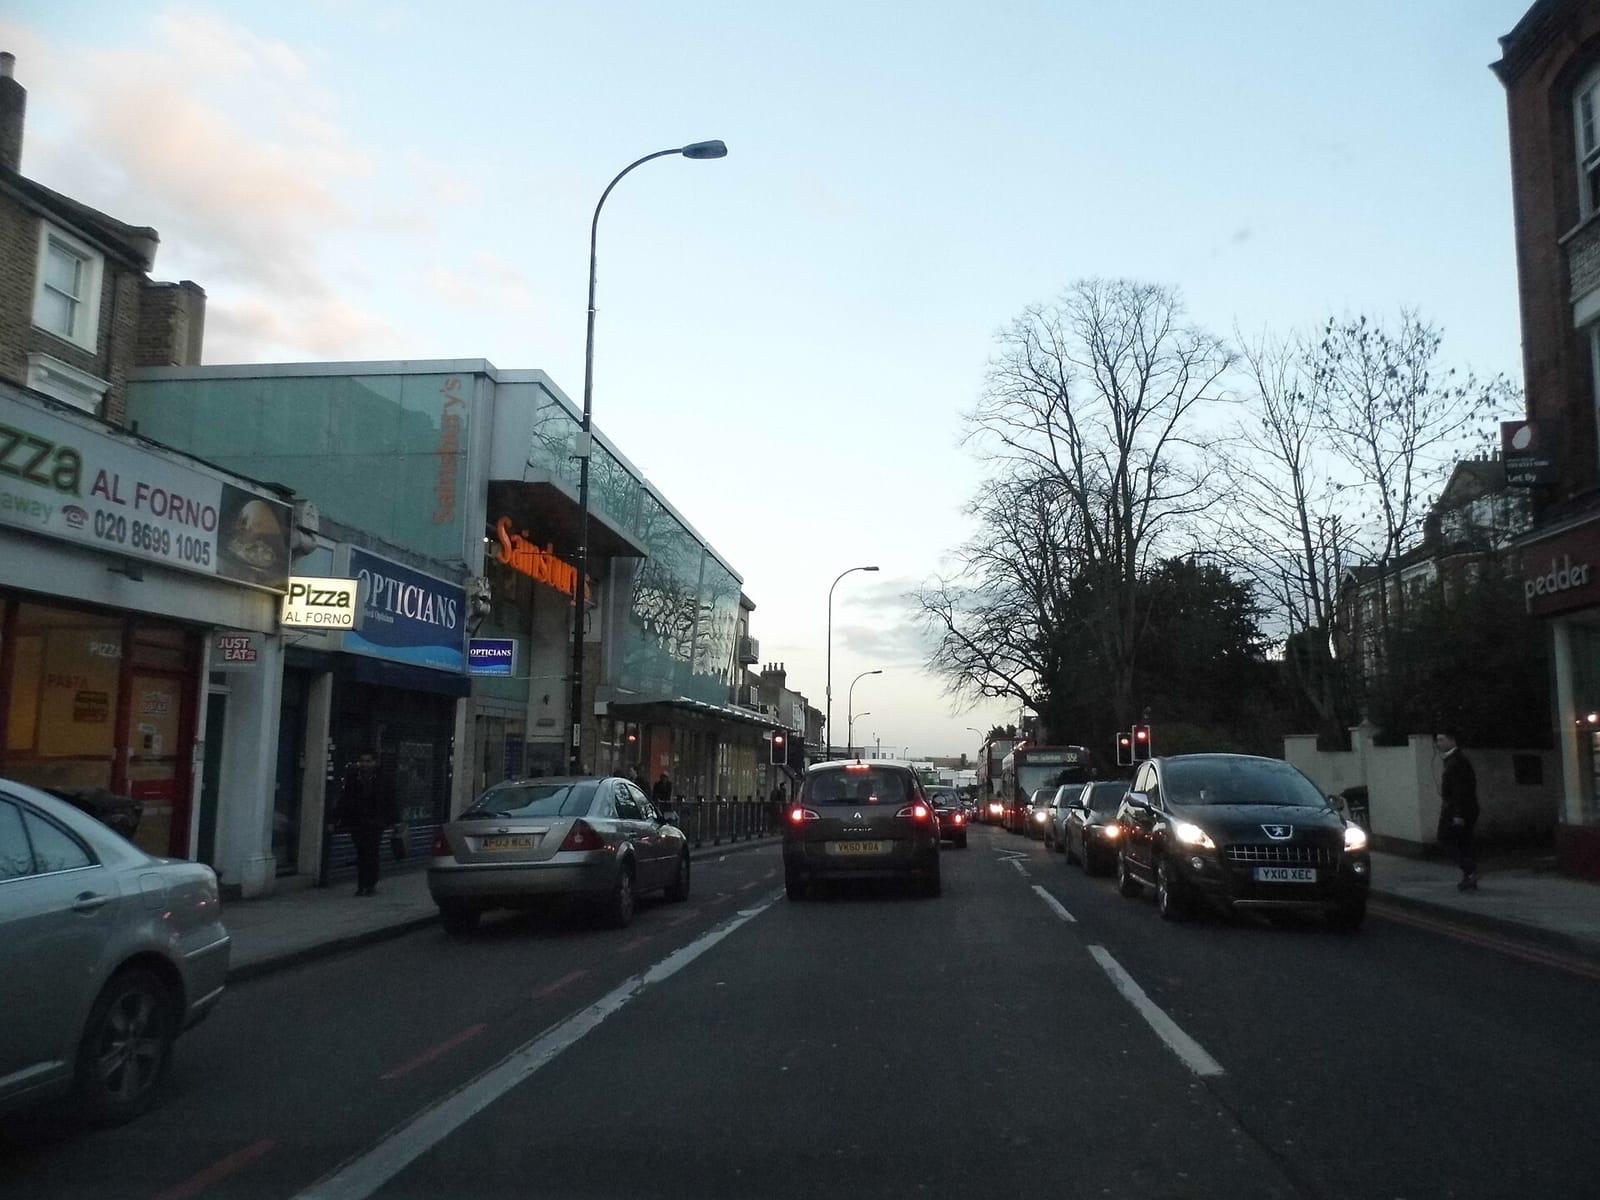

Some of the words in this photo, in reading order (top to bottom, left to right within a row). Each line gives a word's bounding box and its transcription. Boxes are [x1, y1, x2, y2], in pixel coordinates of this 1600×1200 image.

[91, 469, 126, 505] AL
[135, 481, 217, 532] FORNO
[94, 509, 126, 544] 020
[132, 519, 171, 556] 8699
[176, 534, 211, 567] 1005
[1525, 553, 1590, 614] pedder
[288, 582, 350, 609] Pizza
[356, 569, 457, 630] OPTICIANS
[285, 610, 302, 623] AL
[305, 611, 352, 625] FORNO
[218, 637, 249, 649] JUST
[470, 648, 512, 657] OPTICIANS
[225, 649, 248, 660] EAT
[1263, 869, 1288, 879] YX10
[1290, 870, 1312, 879] XEC
